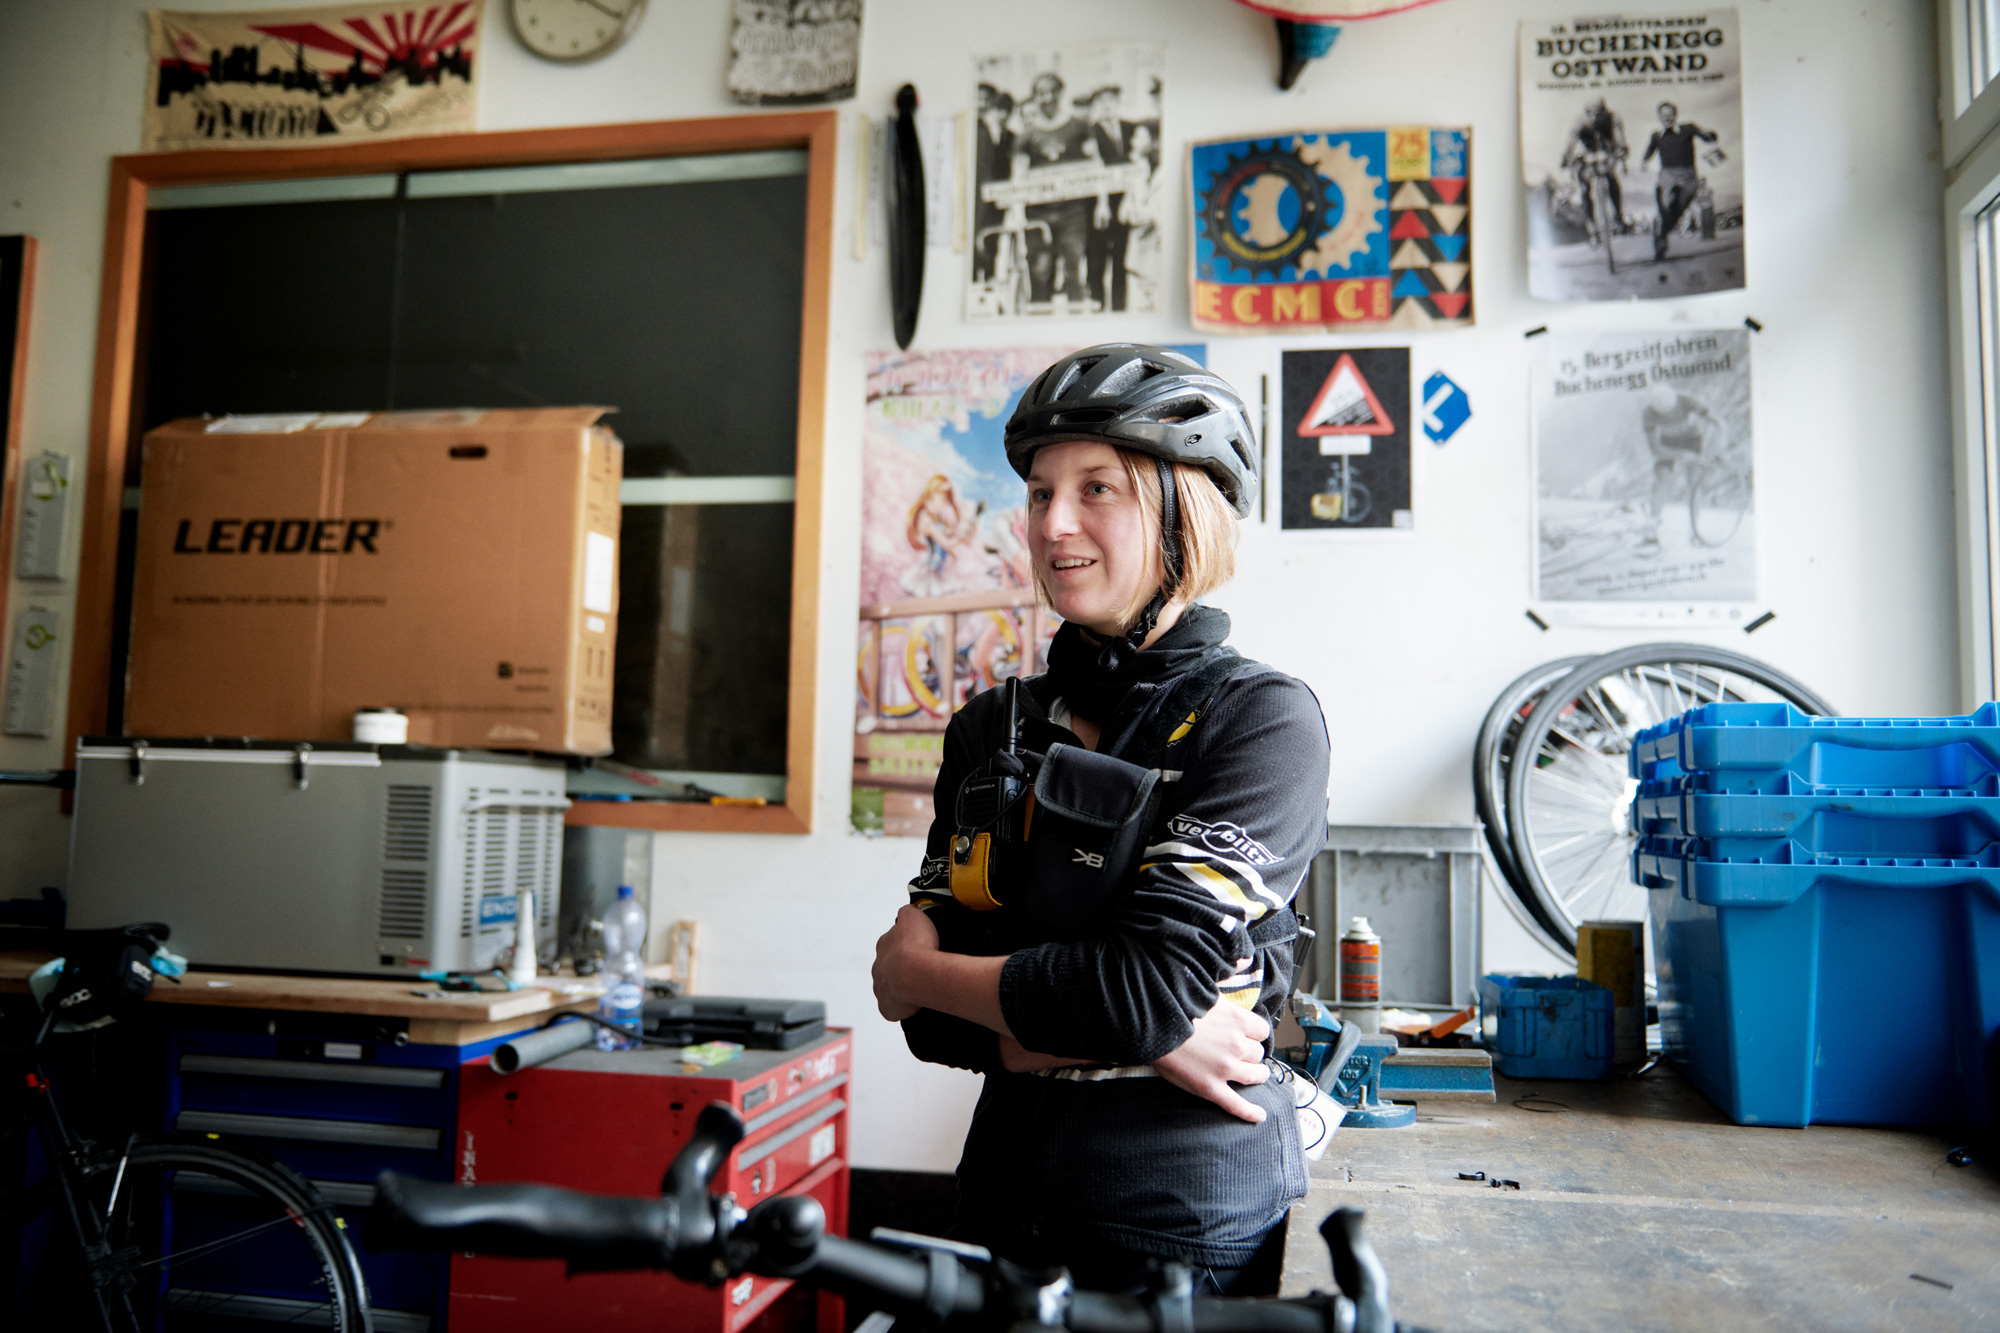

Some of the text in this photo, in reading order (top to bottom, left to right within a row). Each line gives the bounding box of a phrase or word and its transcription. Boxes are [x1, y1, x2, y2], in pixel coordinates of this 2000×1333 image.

[1536, 28, 1725, 57] BUCHENEGG
[1551, 53, 1708, 79] OSTWAND
[1393, 131, 1426, 157] 25
[1197, 280, 1366, 325] ECMC
[1583, 336, 1718, 370] Bergzeitfahren
[1554, 352, 1732, 397] Buchenegg Ostwand
[173, 518, 381, 555] LEADER
[970, 782, 996, 792] MOTOROLA
